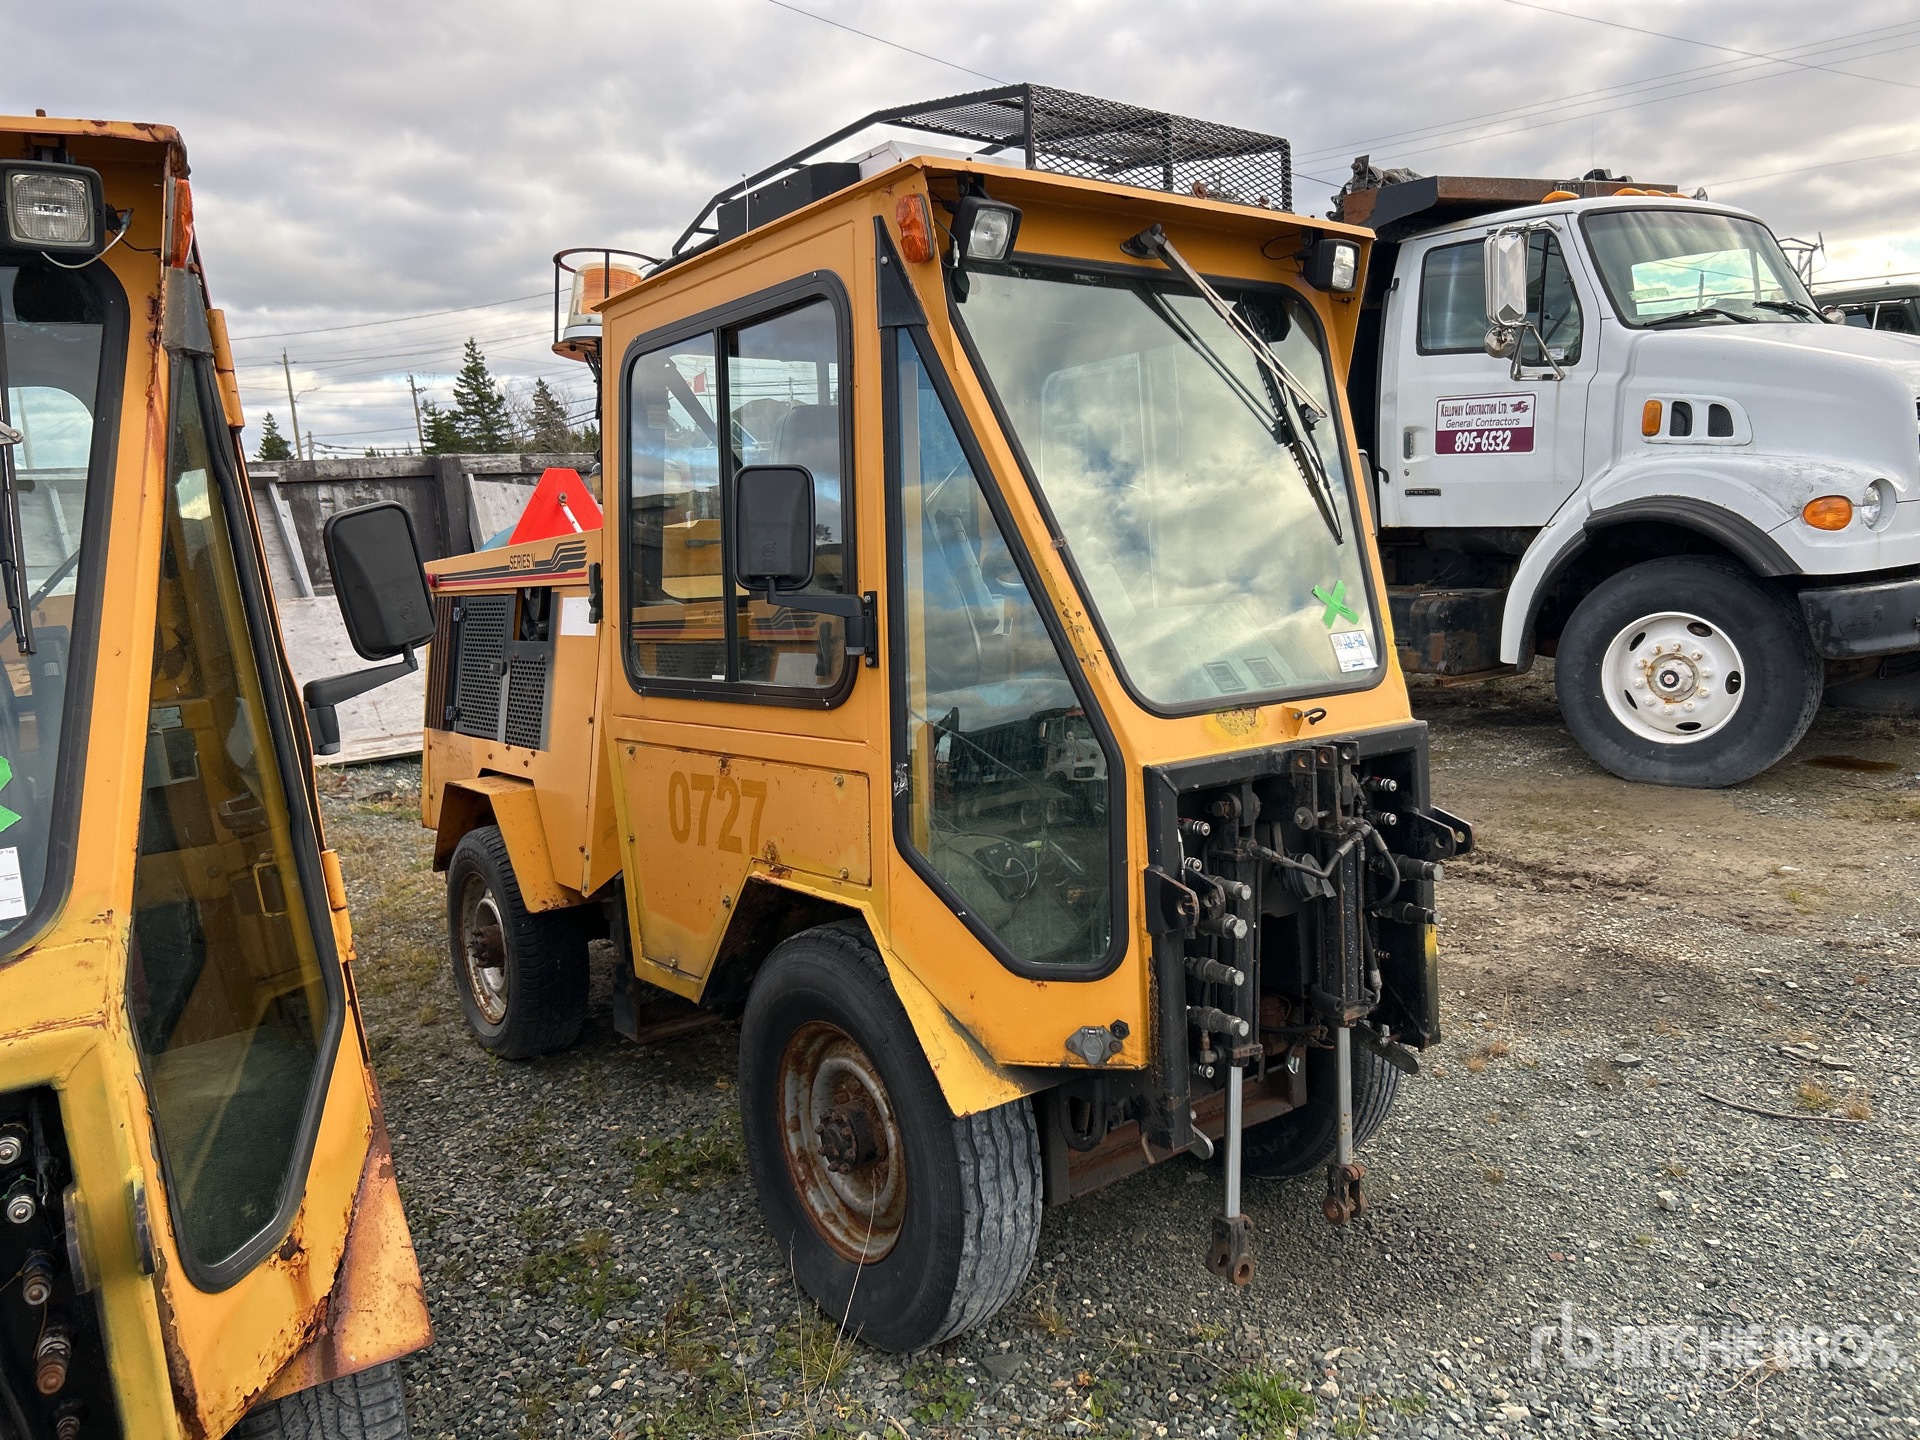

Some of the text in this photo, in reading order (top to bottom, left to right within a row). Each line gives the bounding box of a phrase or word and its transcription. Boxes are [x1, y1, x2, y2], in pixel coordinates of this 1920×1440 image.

[1465, 401, 1497, 416] CONSTRUCTION
[1498, 400, 1508, 415] LTD.
[1446, 417, 1520, 429] General Contractors
[1454, 430, 1512, 452] 895-6532
[510, 552, 536, 570] SERIES V
[669, 771, 768, 856] 0727
